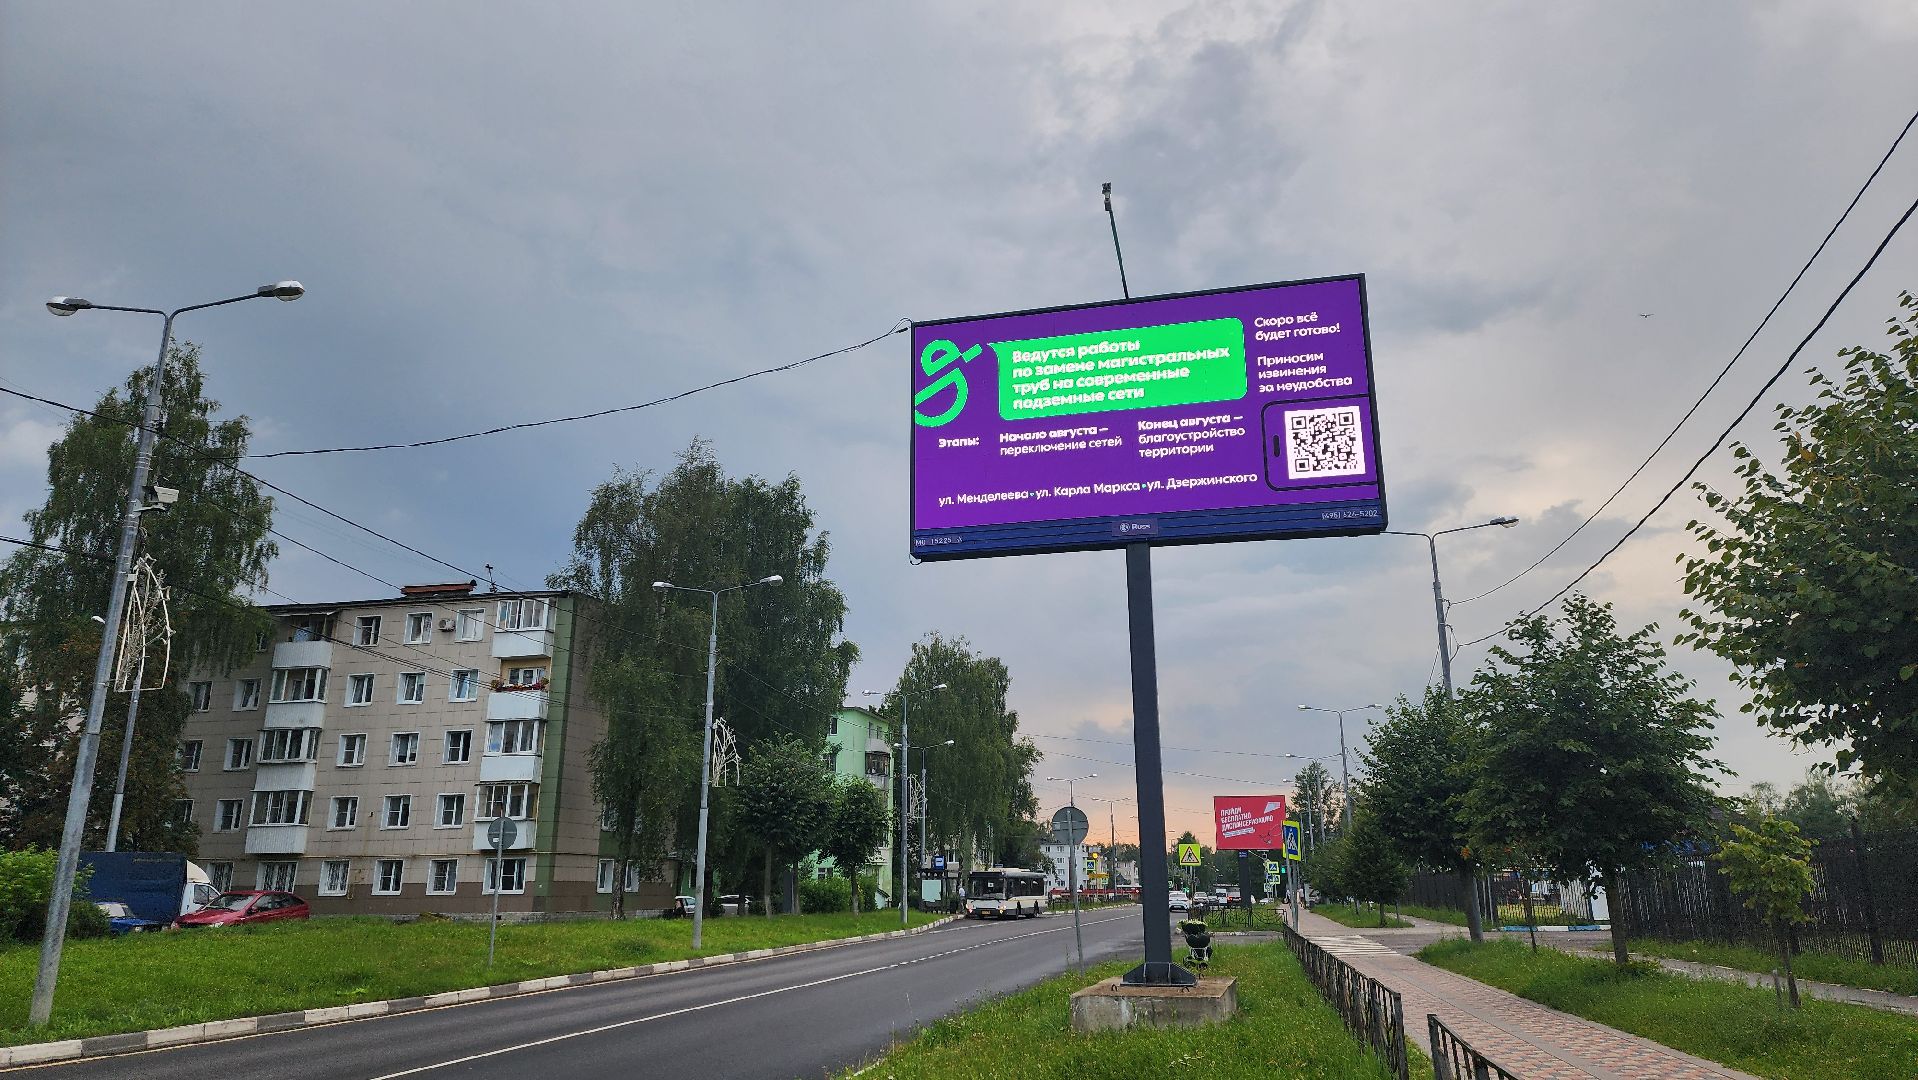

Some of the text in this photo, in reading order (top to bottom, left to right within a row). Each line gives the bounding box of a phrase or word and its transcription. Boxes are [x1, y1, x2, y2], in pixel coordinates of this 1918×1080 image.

[1254, 312, 1318, 327] Скоро всё
[1255, 323, 1340, 341] будет готово!
[1012, 340, 1140, 363] Ведутся работы
[1012, 347, 1230, 378] по замене магистральных
[1257, 353, 1323, 367] Приносим
[1258, 366, 1326, 379] извинения
[1012, 367, 1190, 395] труб на современные
[1259, 377, 1352, 392] за неудобства
[1013, 387, 1144, 410] подземные сети
[1138, 419, 1178, 431] Конец
[1180, 414, 1230, 428] августа
[939, 437, 979, 447] Этапы:
[1000, 430, 1047, 442] Начало
[1049, 426, 1097, 439] августа
[1139, 428, 1245, 444] благоустройство
[1000, 436, 1122, 456] переключение сетей
[1139, 444, 1214, 458] территории
[939, 473, 1258, 507] ул. Менделеева ул. Карла Маркса ул. Дзержинского
